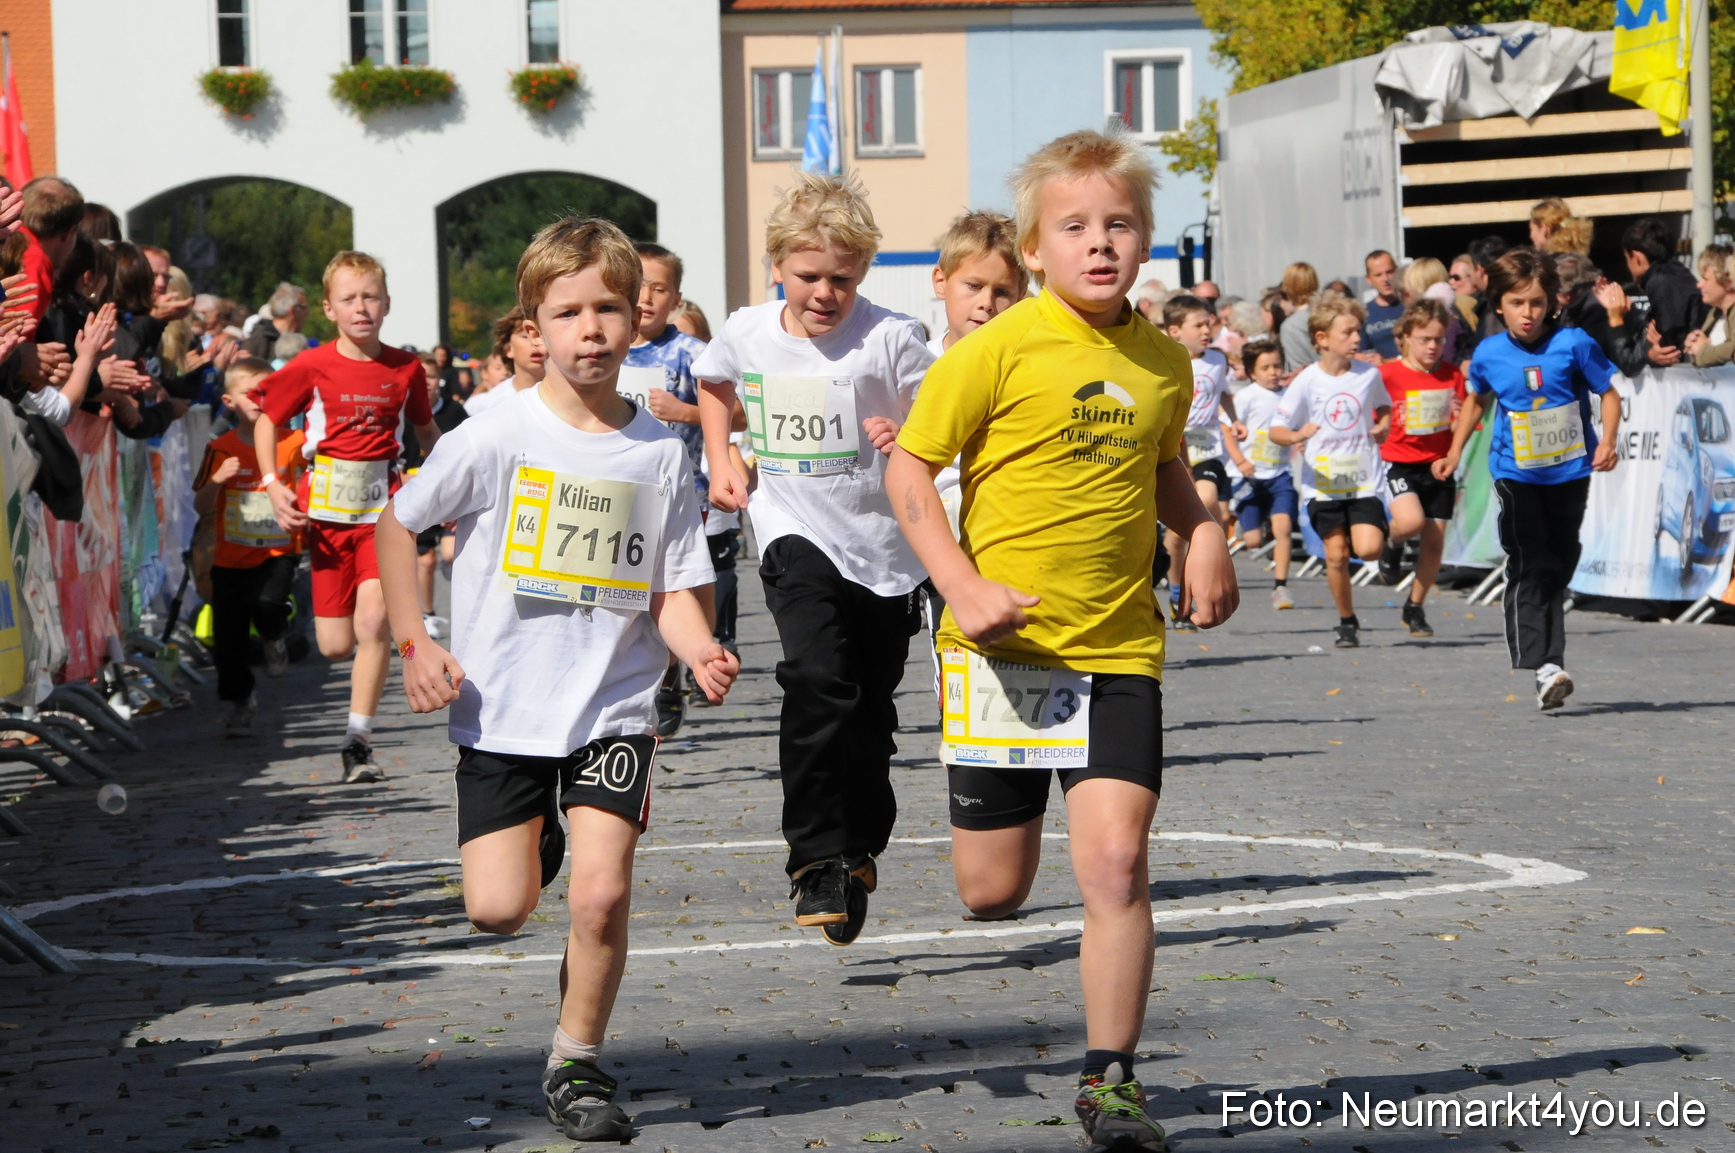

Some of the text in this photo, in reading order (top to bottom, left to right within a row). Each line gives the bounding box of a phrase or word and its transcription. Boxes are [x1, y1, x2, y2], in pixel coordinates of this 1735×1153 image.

[1071, 405, 1135, 426] skinfit
[1530, 413, 1558, 427] David
[771, 413, 843, 442] 7301
[1535, 424, 1578, 448] 7006
[1060, 429, 1138, 451] TV Hilpoltstein
[812, 456, 858, 468] PFLEIDERER
[1073, 449, 1121, 467] Triathlon
[334, 484, 382, 502] 7030
[1390, 477, 1408, 494] 16
[558, 482, 611, 513] Kilian
[516, 514, 536, 534] K4
[556, 523, 645, 567] 7116
[598, 586, 648, 602] PFLEIDERER
[948, 682, 962, 701] K4
[977, 686, 1076, 723] 7273
[1027, 747, 1085, 758] PFLEIDERER
[572, 741, 638, 792] 20
